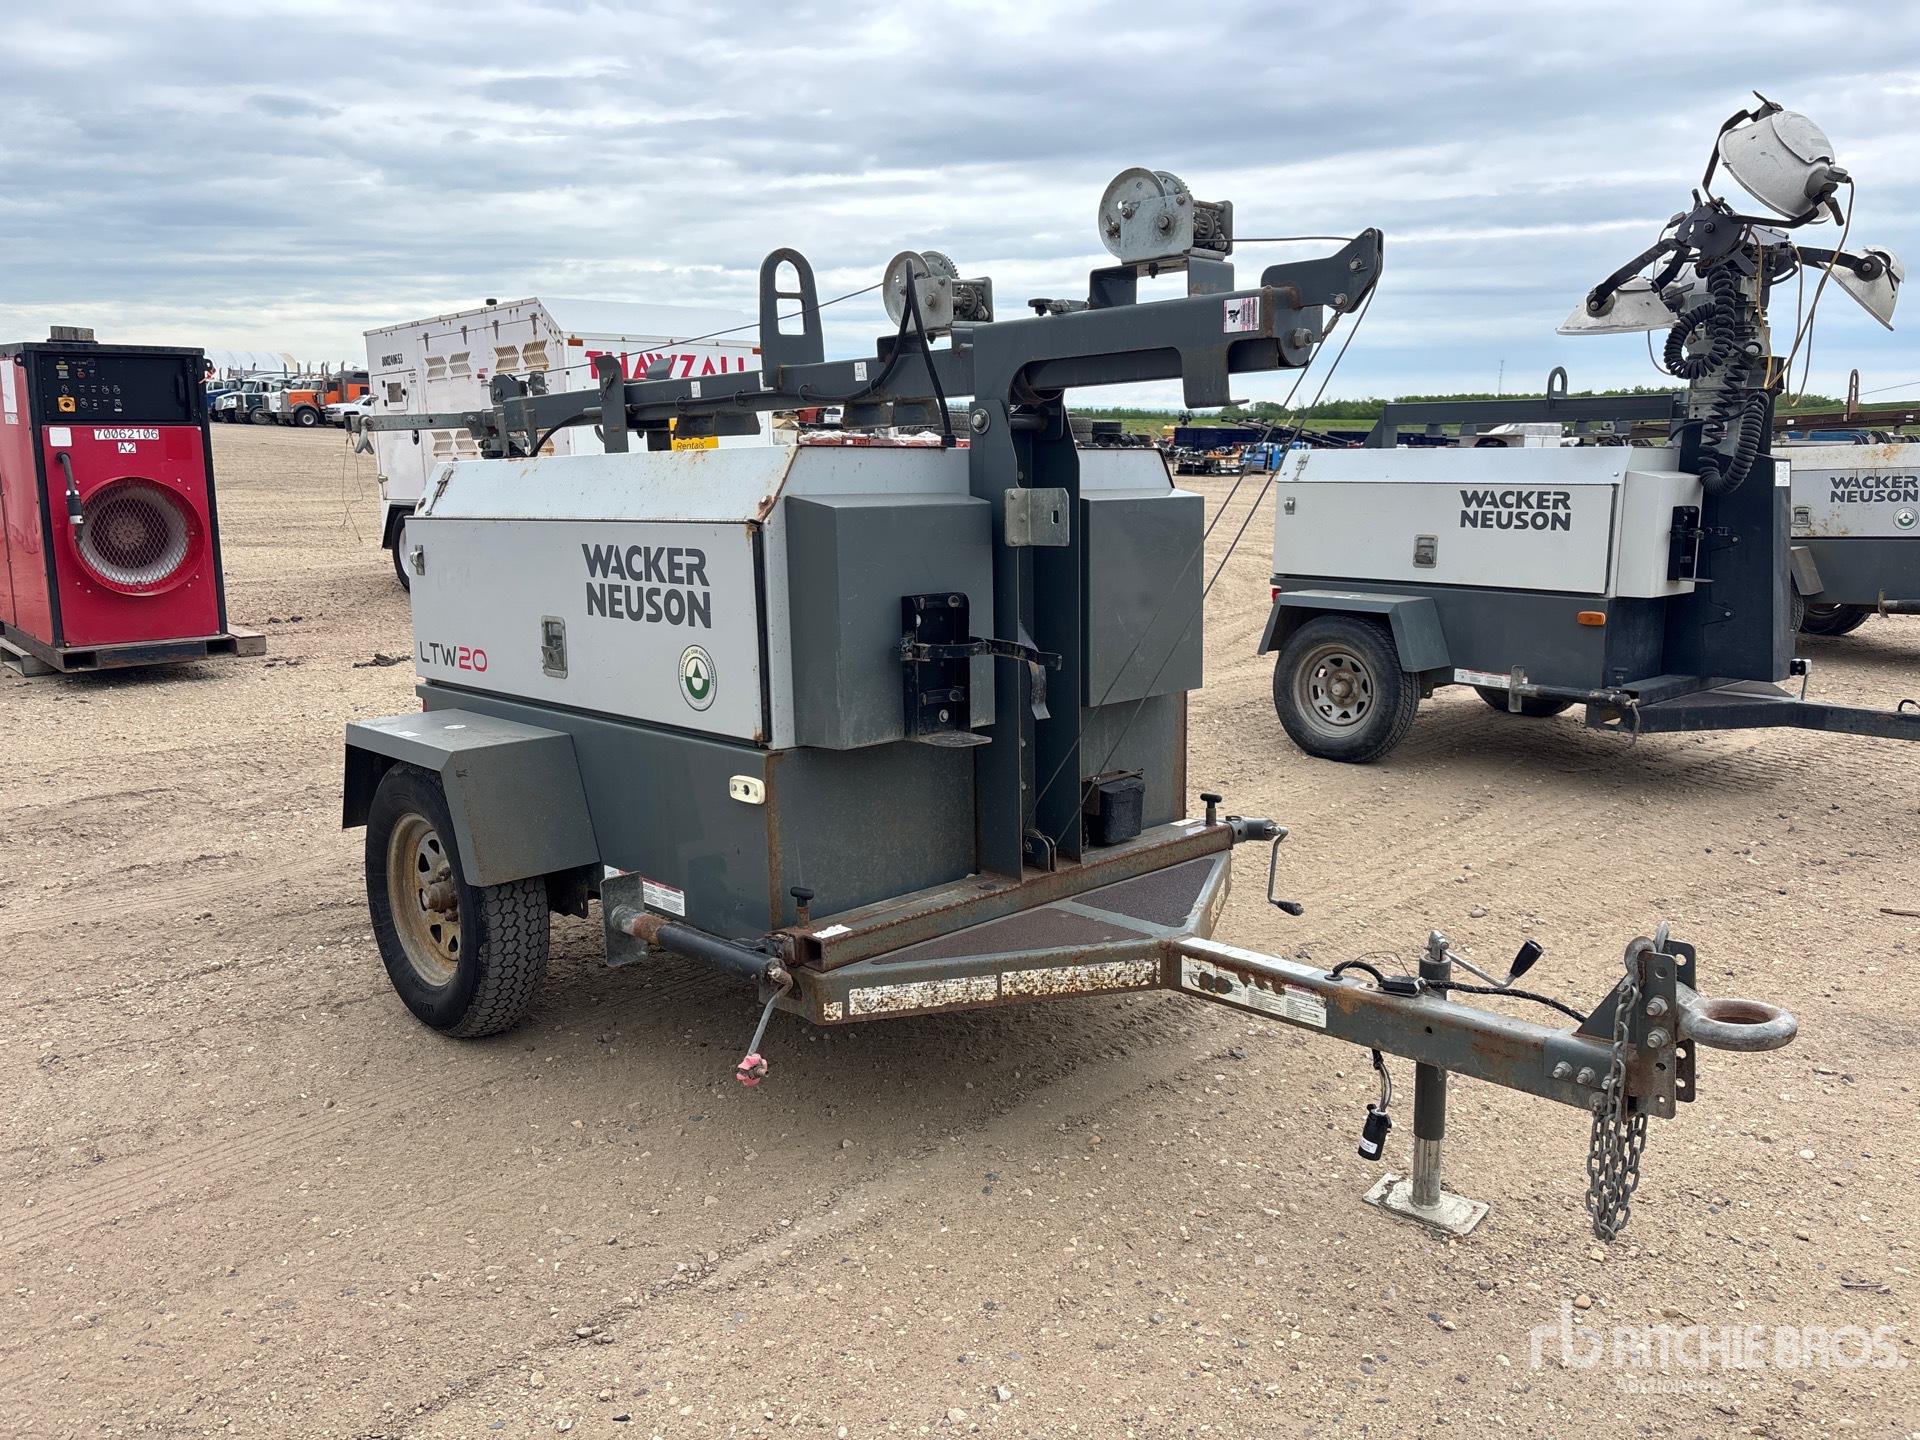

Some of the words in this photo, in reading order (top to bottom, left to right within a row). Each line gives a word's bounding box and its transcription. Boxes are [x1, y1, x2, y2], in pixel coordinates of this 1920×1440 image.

[94, 429, 159, 440] 70062106
[119, 442, 136, 453] A2
[1829, 475, 1919, 489] WACKER
[1460, 490, 1571, 510] WACKER
[1829, 489, 1919, 503] NEUSON
[1460, 510, 1571, 531] NEUSON
[581, 543, 710, 587] WACKER
[585, 582, 712, 629] NEUSON
[419, 640, 488, 673] LTW20
